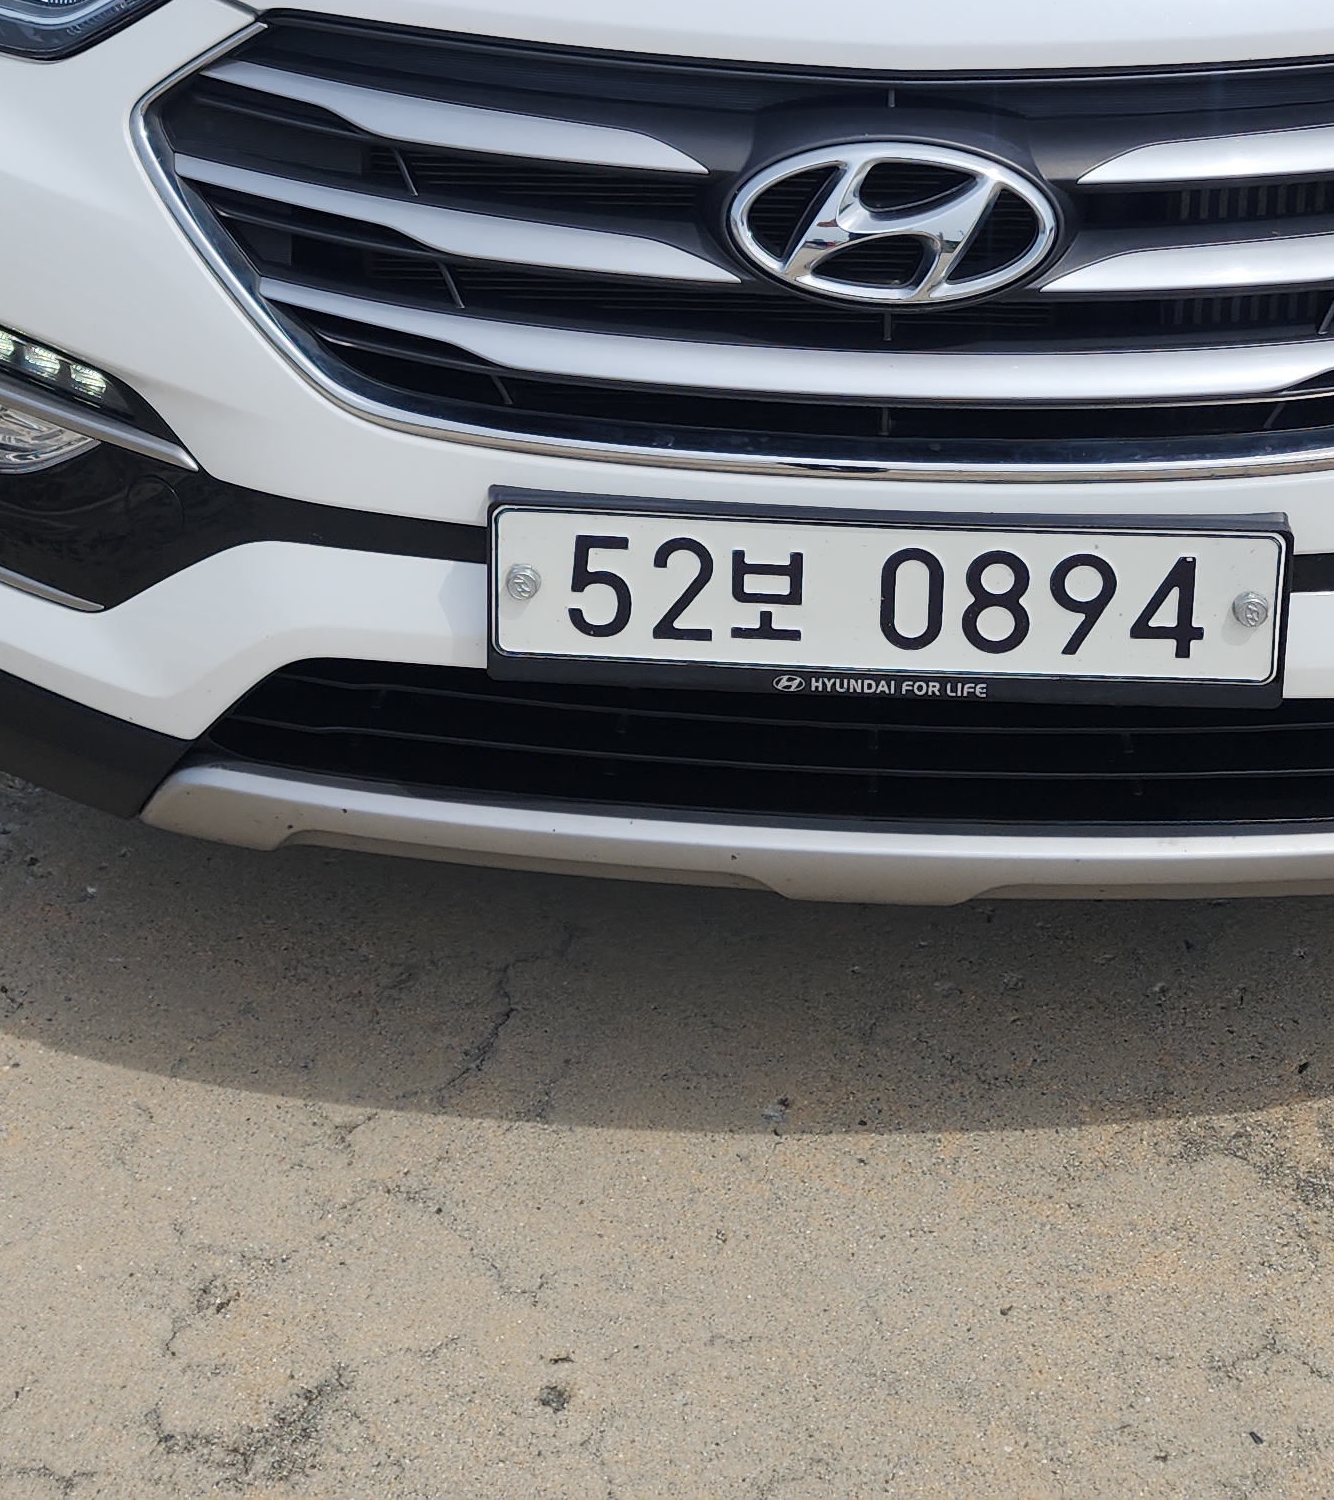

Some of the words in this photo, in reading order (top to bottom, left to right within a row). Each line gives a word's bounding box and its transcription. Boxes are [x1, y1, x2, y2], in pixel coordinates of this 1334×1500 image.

[568, 534, 804, 642] 52보
[879, 546, 1205, 660] 0894
[810, 677, 896, 696] HYUNDAI
[901, 680, 941, 697] FOR
[946, 682, 988, 699] LIFE
